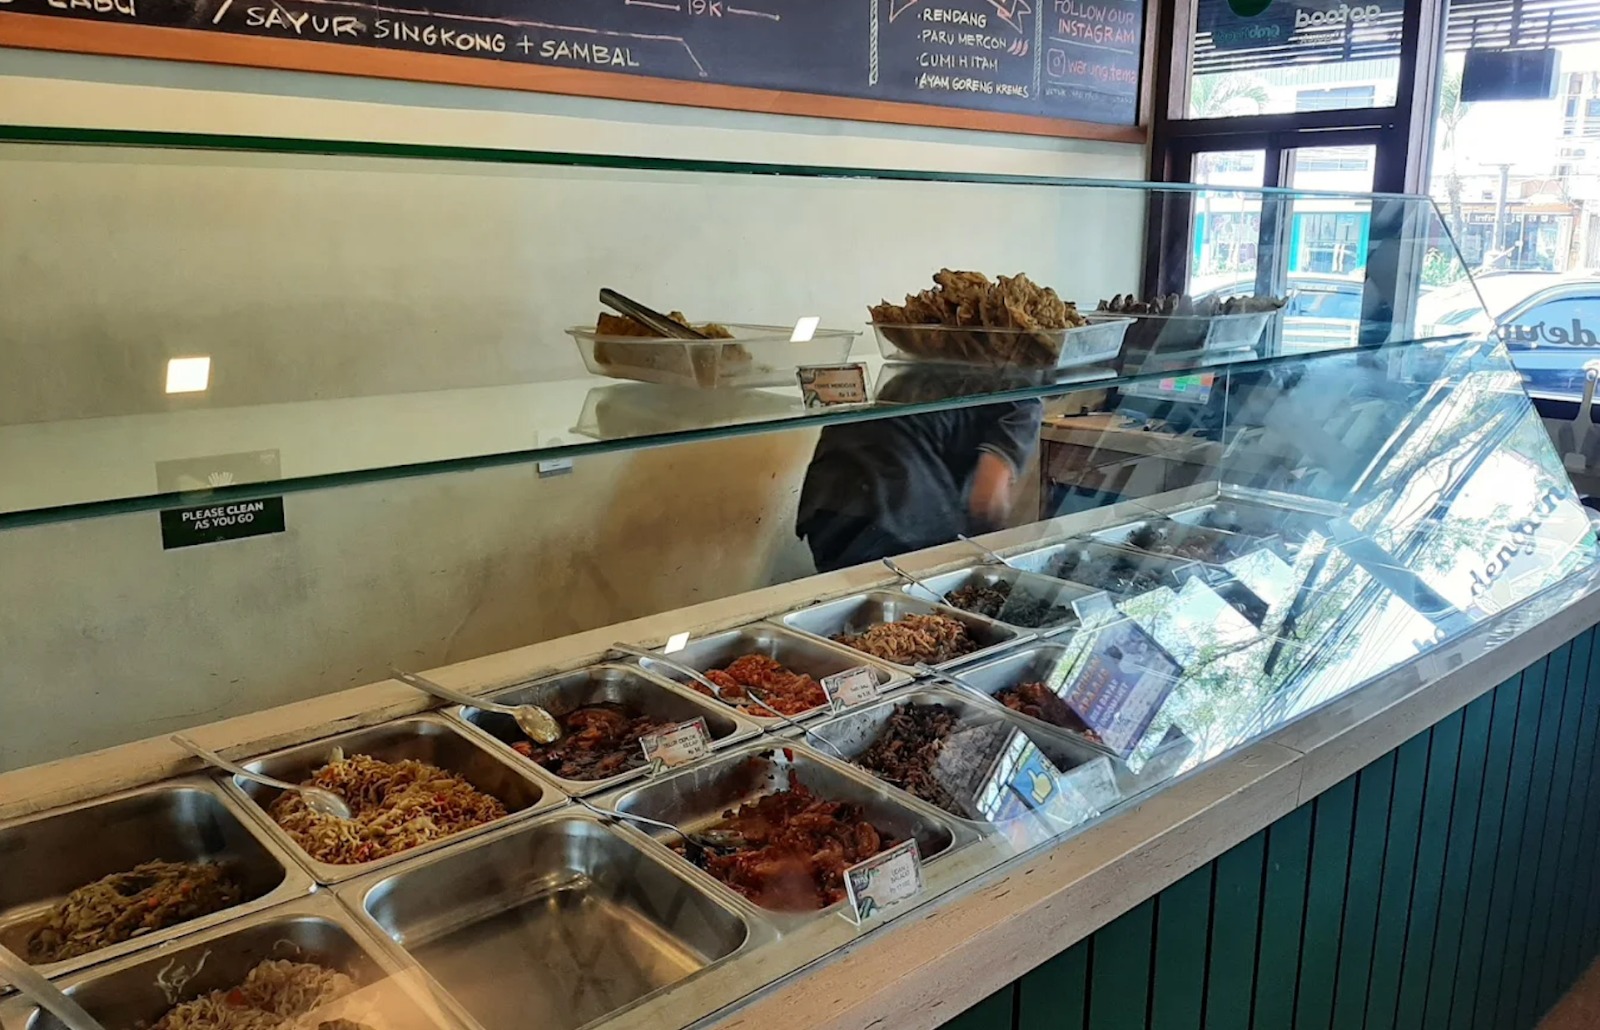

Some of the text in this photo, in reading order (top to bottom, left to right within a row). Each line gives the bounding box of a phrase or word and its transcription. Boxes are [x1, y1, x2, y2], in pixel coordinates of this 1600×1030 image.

[923, 8, 987, 28] RENDANG
[1054, 0, 1135, 25] FOLLOW OUR
[246, 7, 640, 67] SAYUR SINGKONG + SAMBAL
[922, 29, 1007, 50] PARU MERCON
[1058, 18, 1135, 44] INSTAGRAM
[918, 73, 950, 92] AYAM
[952, 77, 993, 95] GORENG
[182, 501, 264, 522] PLEASE CLEAN
[194, 513, 255, 530] AS YOU GO
